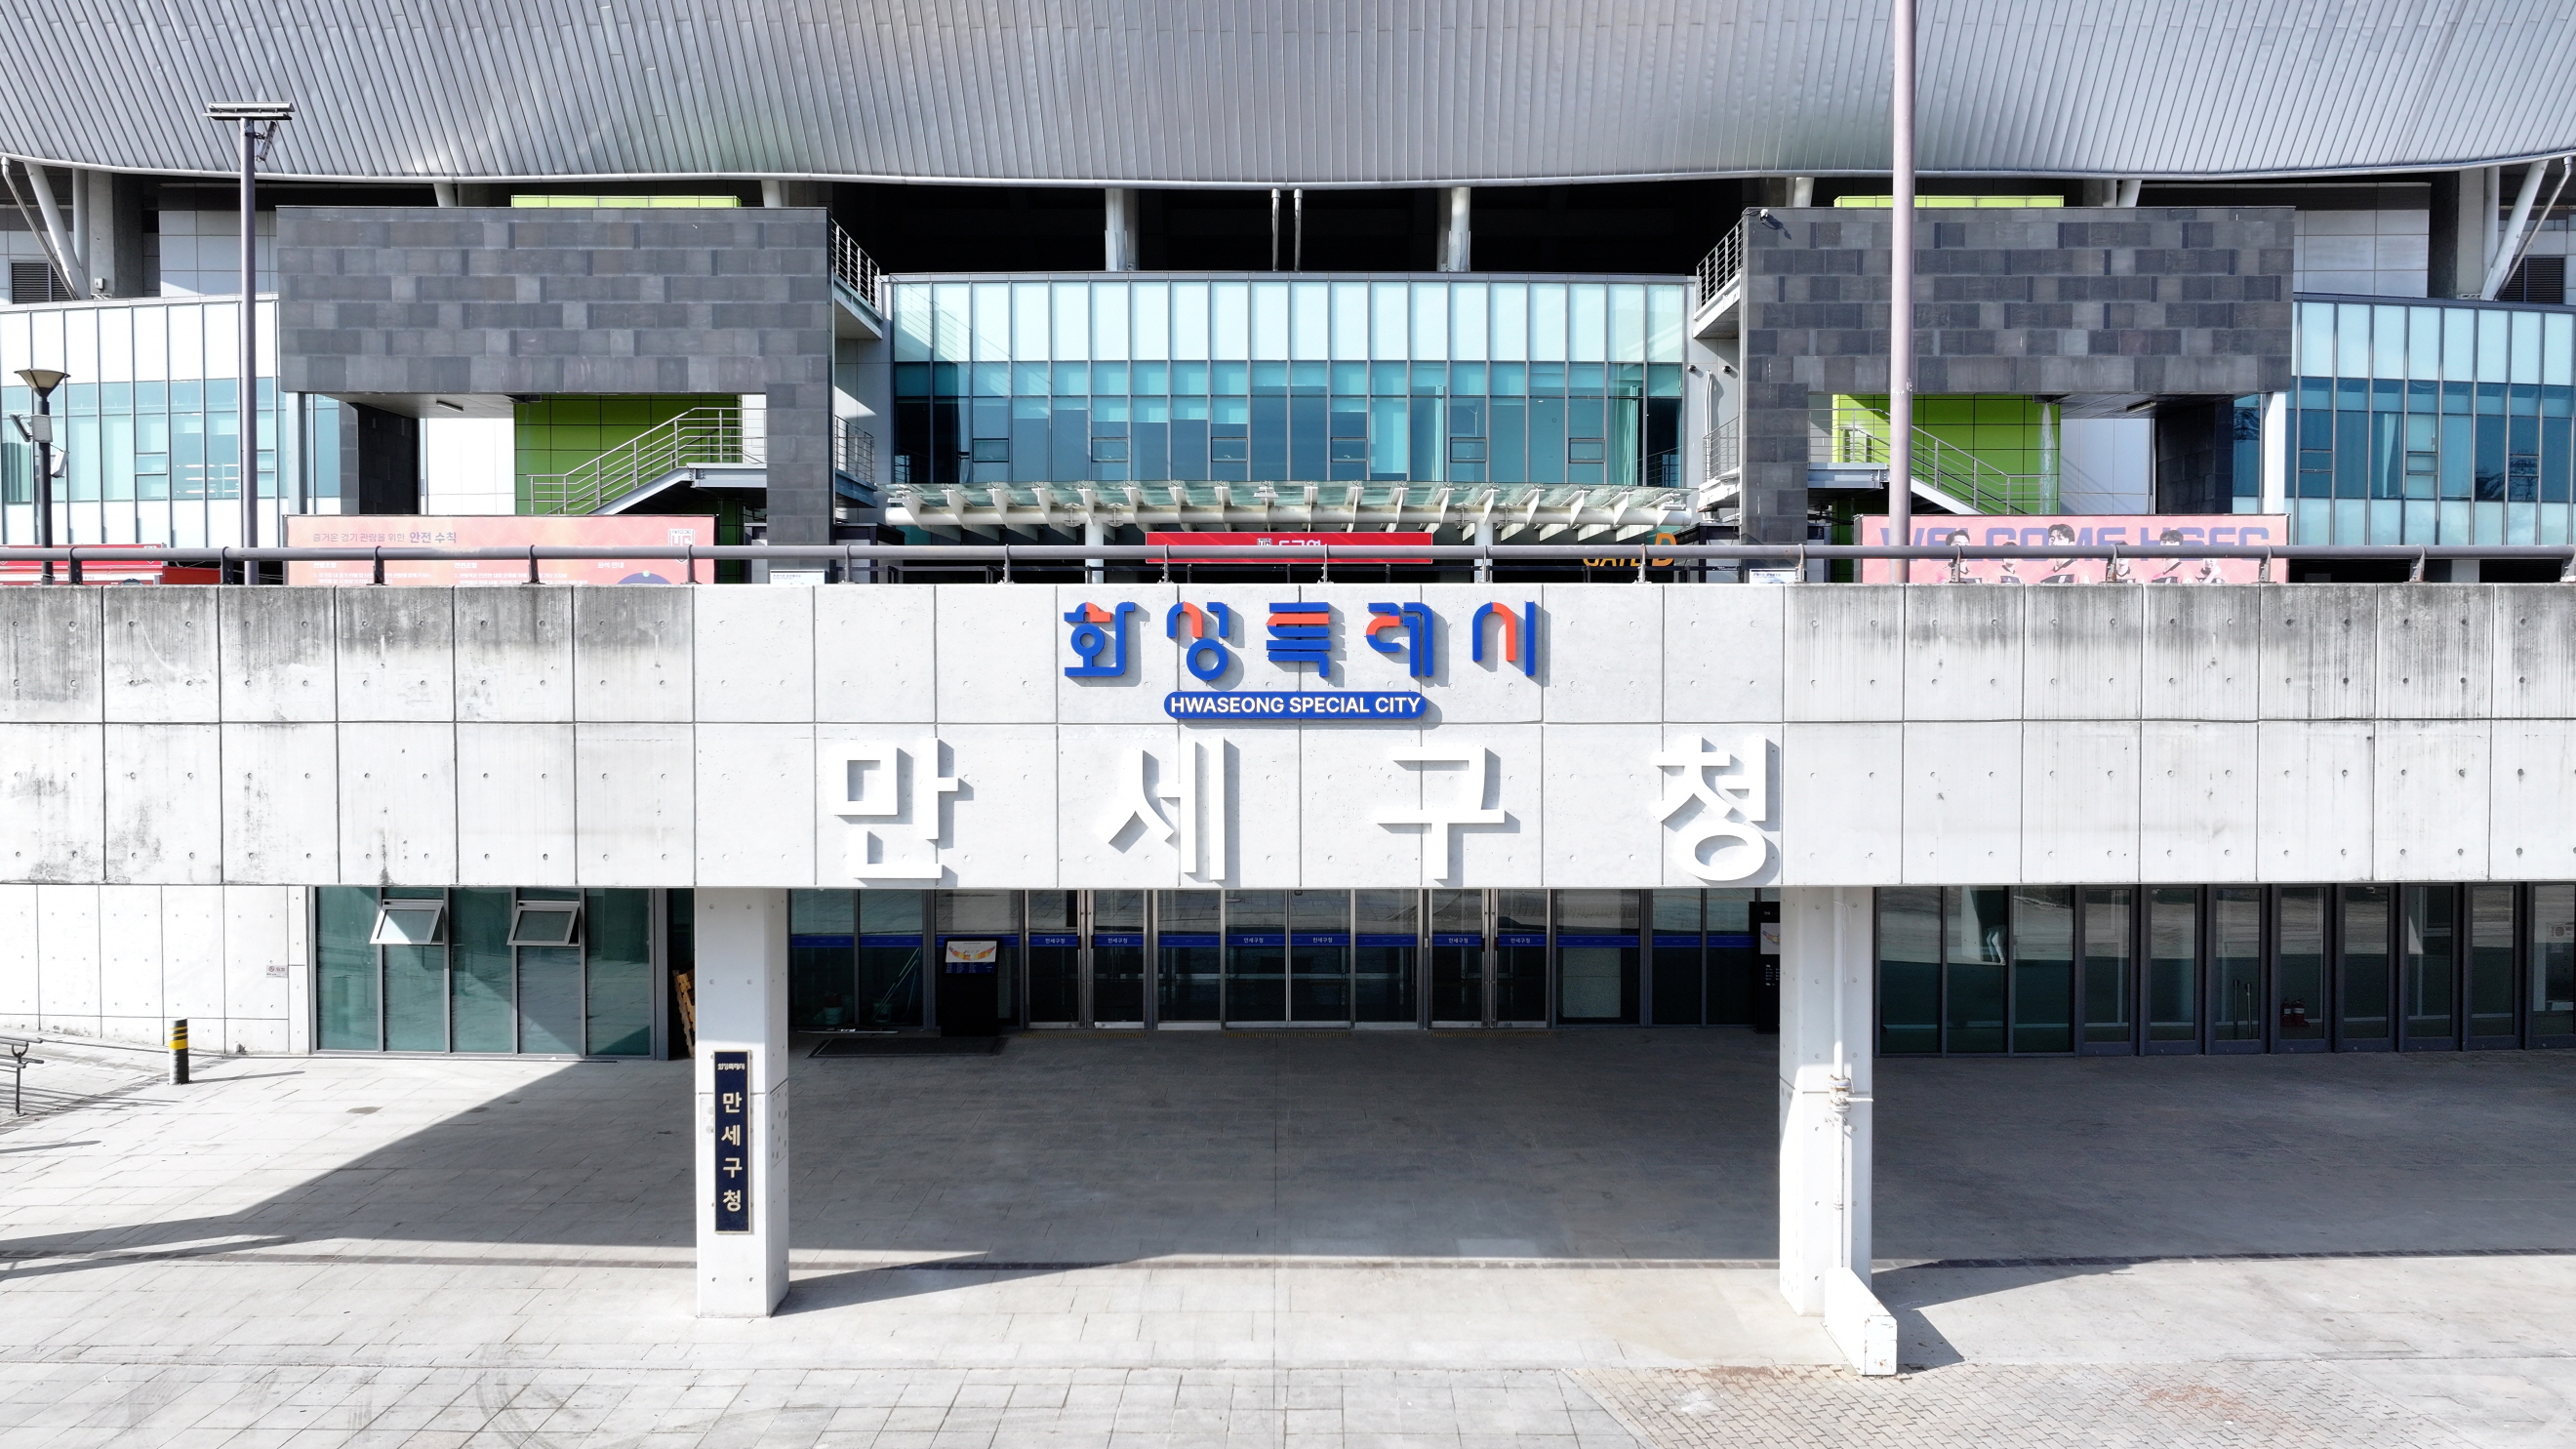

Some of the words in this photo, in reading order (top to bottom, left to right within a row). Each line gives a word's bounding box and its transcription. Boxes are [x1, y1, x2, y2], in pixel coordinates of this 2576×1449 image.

[341, 533, 358, 543] 경기
[360, 533, 385, 543] 관람을
[387, 533, 405, 543] 위한
[409, 532, 431, 543] 안전
[434, 532, 457, 543] 수칙
[1651, 533, 1677, 567] D
[1064, 601, 1535, 682] 화성특례시
[1171, 697, 1284, 713] HWASEONG
[1289, 697, 1370, 713] SPECIAL
[1375, 697, 1421, 713] CITY
[826, 735, 1767, 882] 만세구청
[721, 1091, 743, 1213] 만세구청
